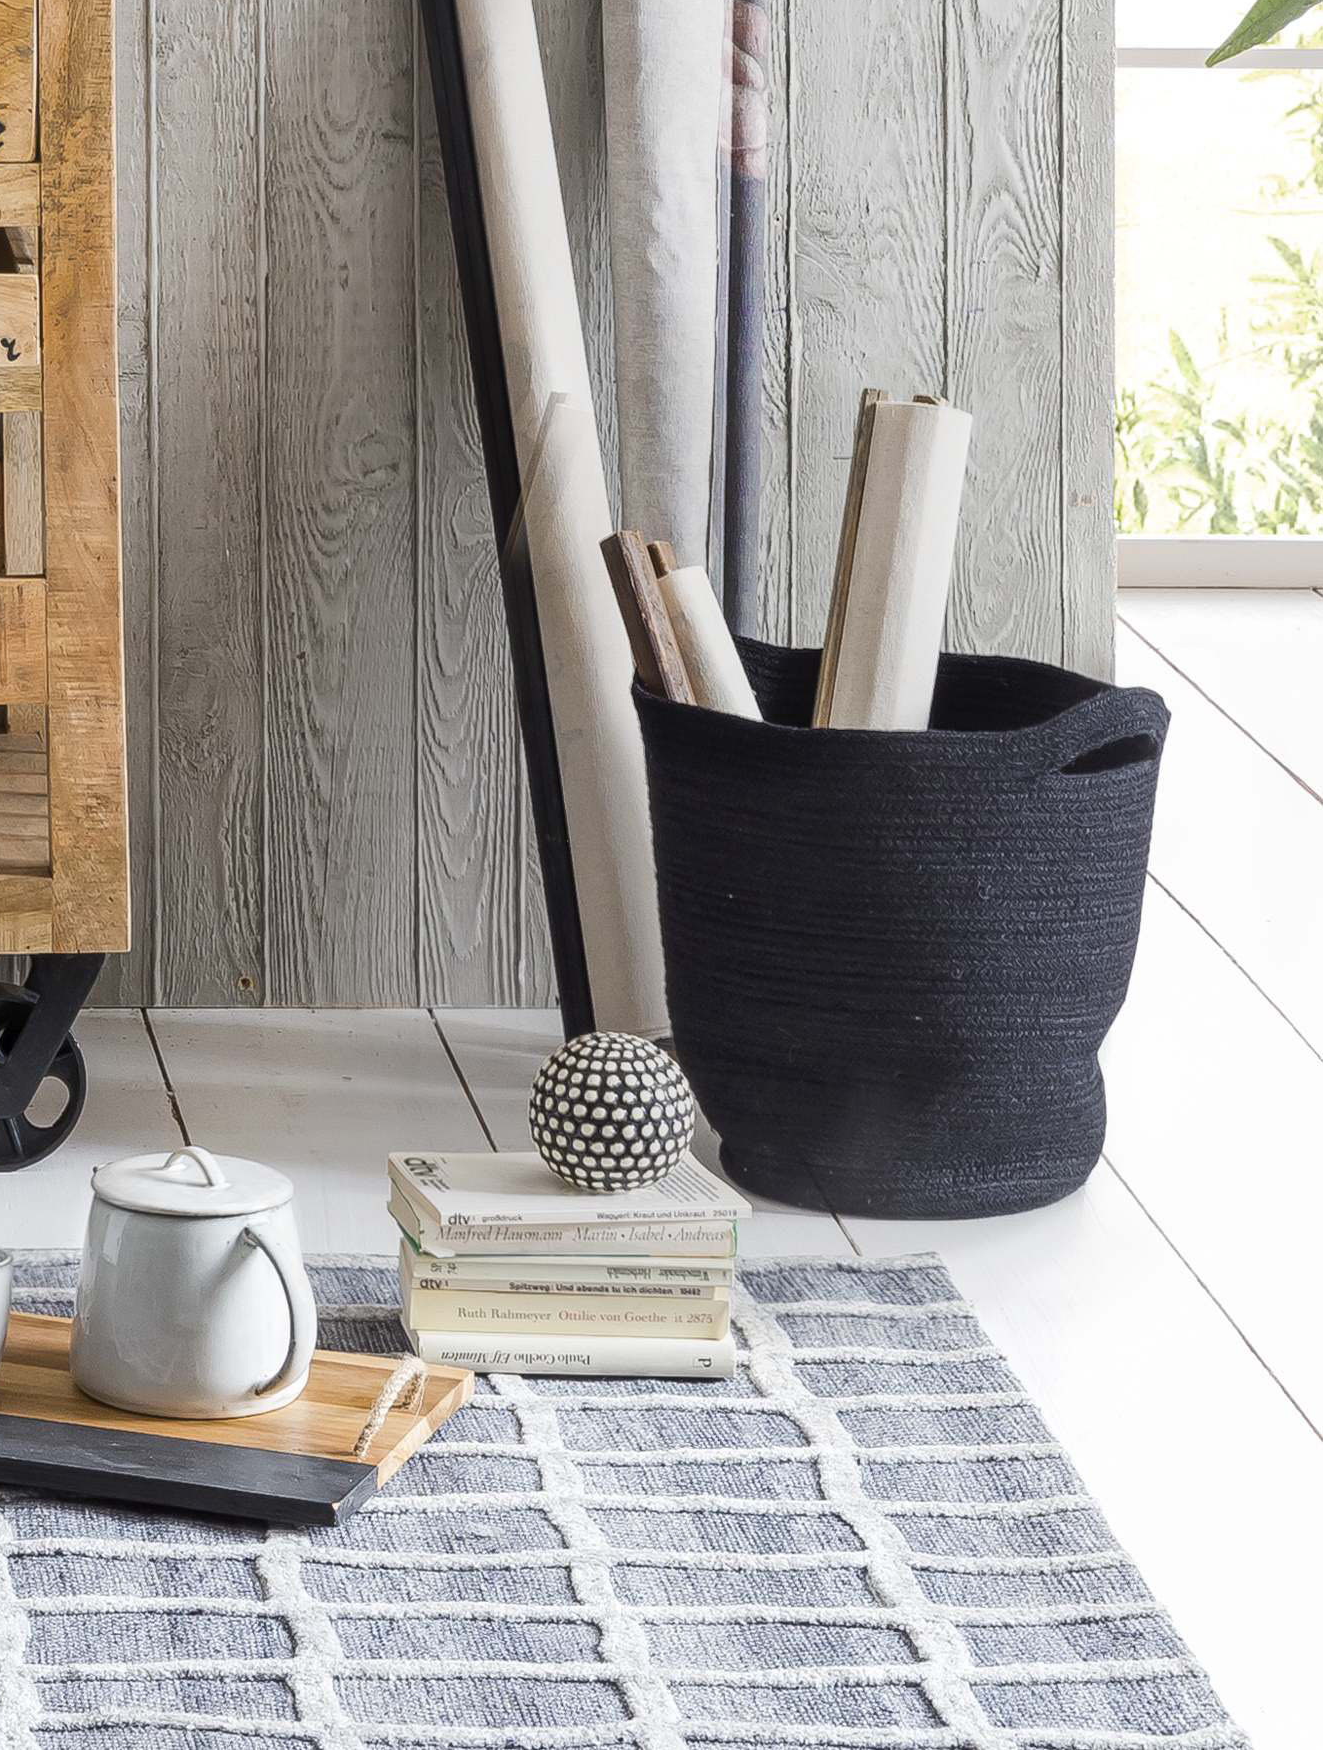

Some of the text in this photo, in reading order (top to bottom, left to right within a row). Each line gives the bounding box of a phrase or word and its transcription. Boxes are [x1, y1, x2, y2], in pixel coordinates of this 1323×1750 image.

[447, 1212, 470, 1226] dtv
[435, 1225, 726, 1242] Manfred Hausmann Martin Isabel Andreas
[419, 1278, 442, 1290] dtv
[556, 1282, 574, 1291] Und
[576, 1284, 609, 1293] abends
[623, 1285, 637, 1294] ich
[639, 1286, 674, 1295] dichten
[457, 1307, 487, 1319] Ruth
[491, 1307, 551, 1323] Rahmeyer
[558, 1310, 597, 1322] Ottilie
[600, 1314, 621, 1322] von
[624, 1311, 668, 1323] Goethe
[687, 1313, 714, 1324] 2875
[440, 1351, 591, 1366] Paulo Coelho Elf Minuten
